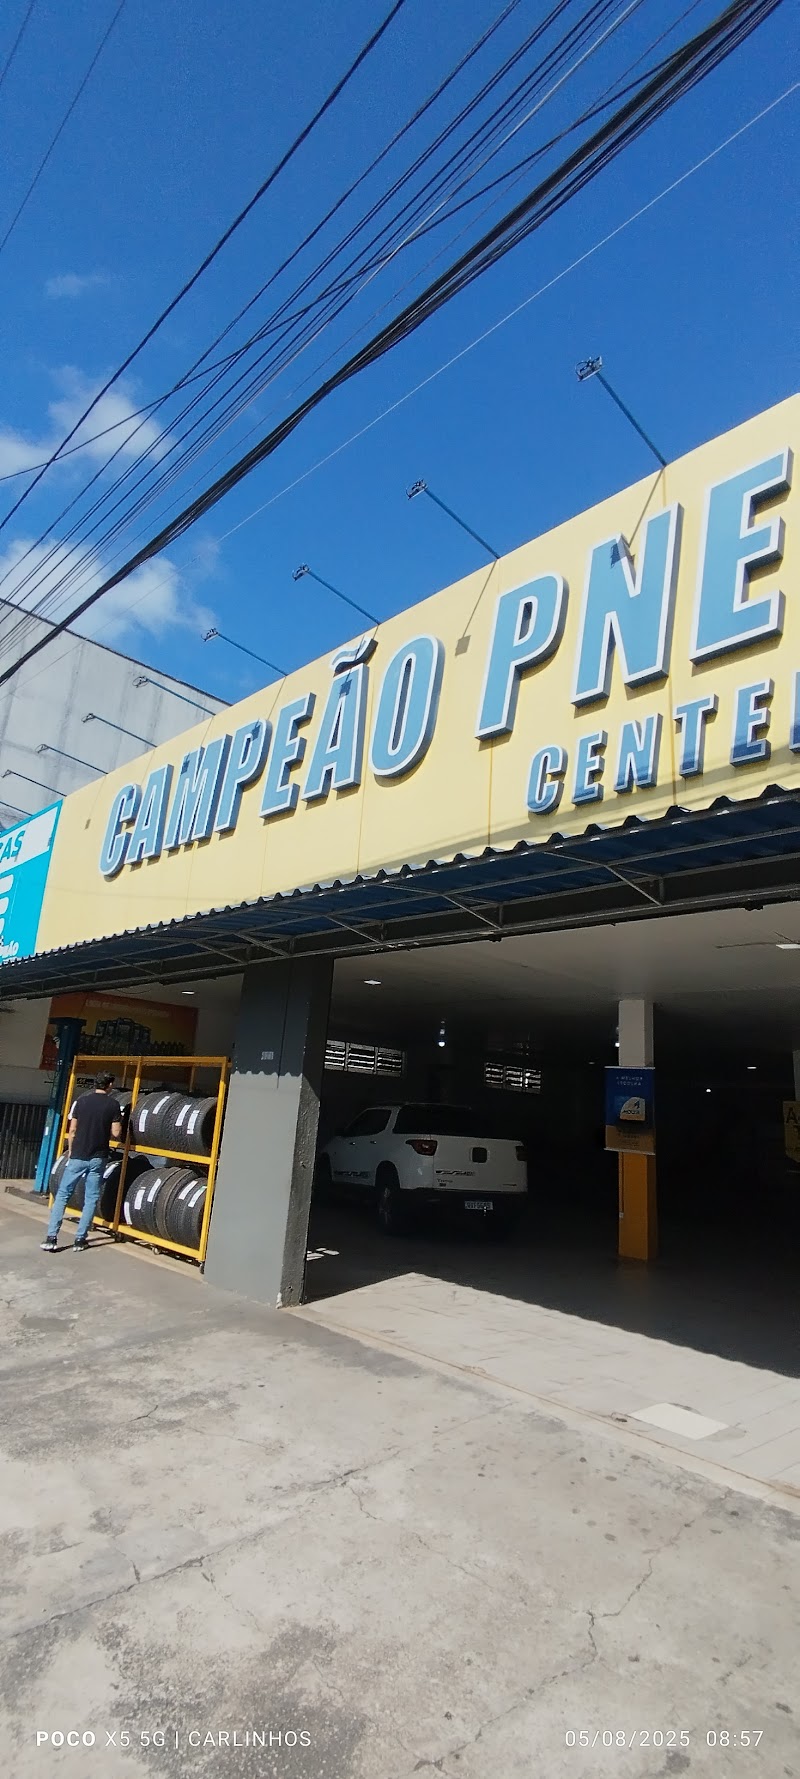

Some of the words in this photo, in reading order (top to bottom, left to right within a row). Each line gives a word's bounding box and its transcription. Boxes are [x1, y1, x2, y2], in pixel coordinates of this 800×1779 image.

[98, 636, 445, 877] CAMPEÃO
[475, 446, 795, 741] PNE
[526, 671, 800, 816] CENTE
[0, 829, 26, 863] AS
